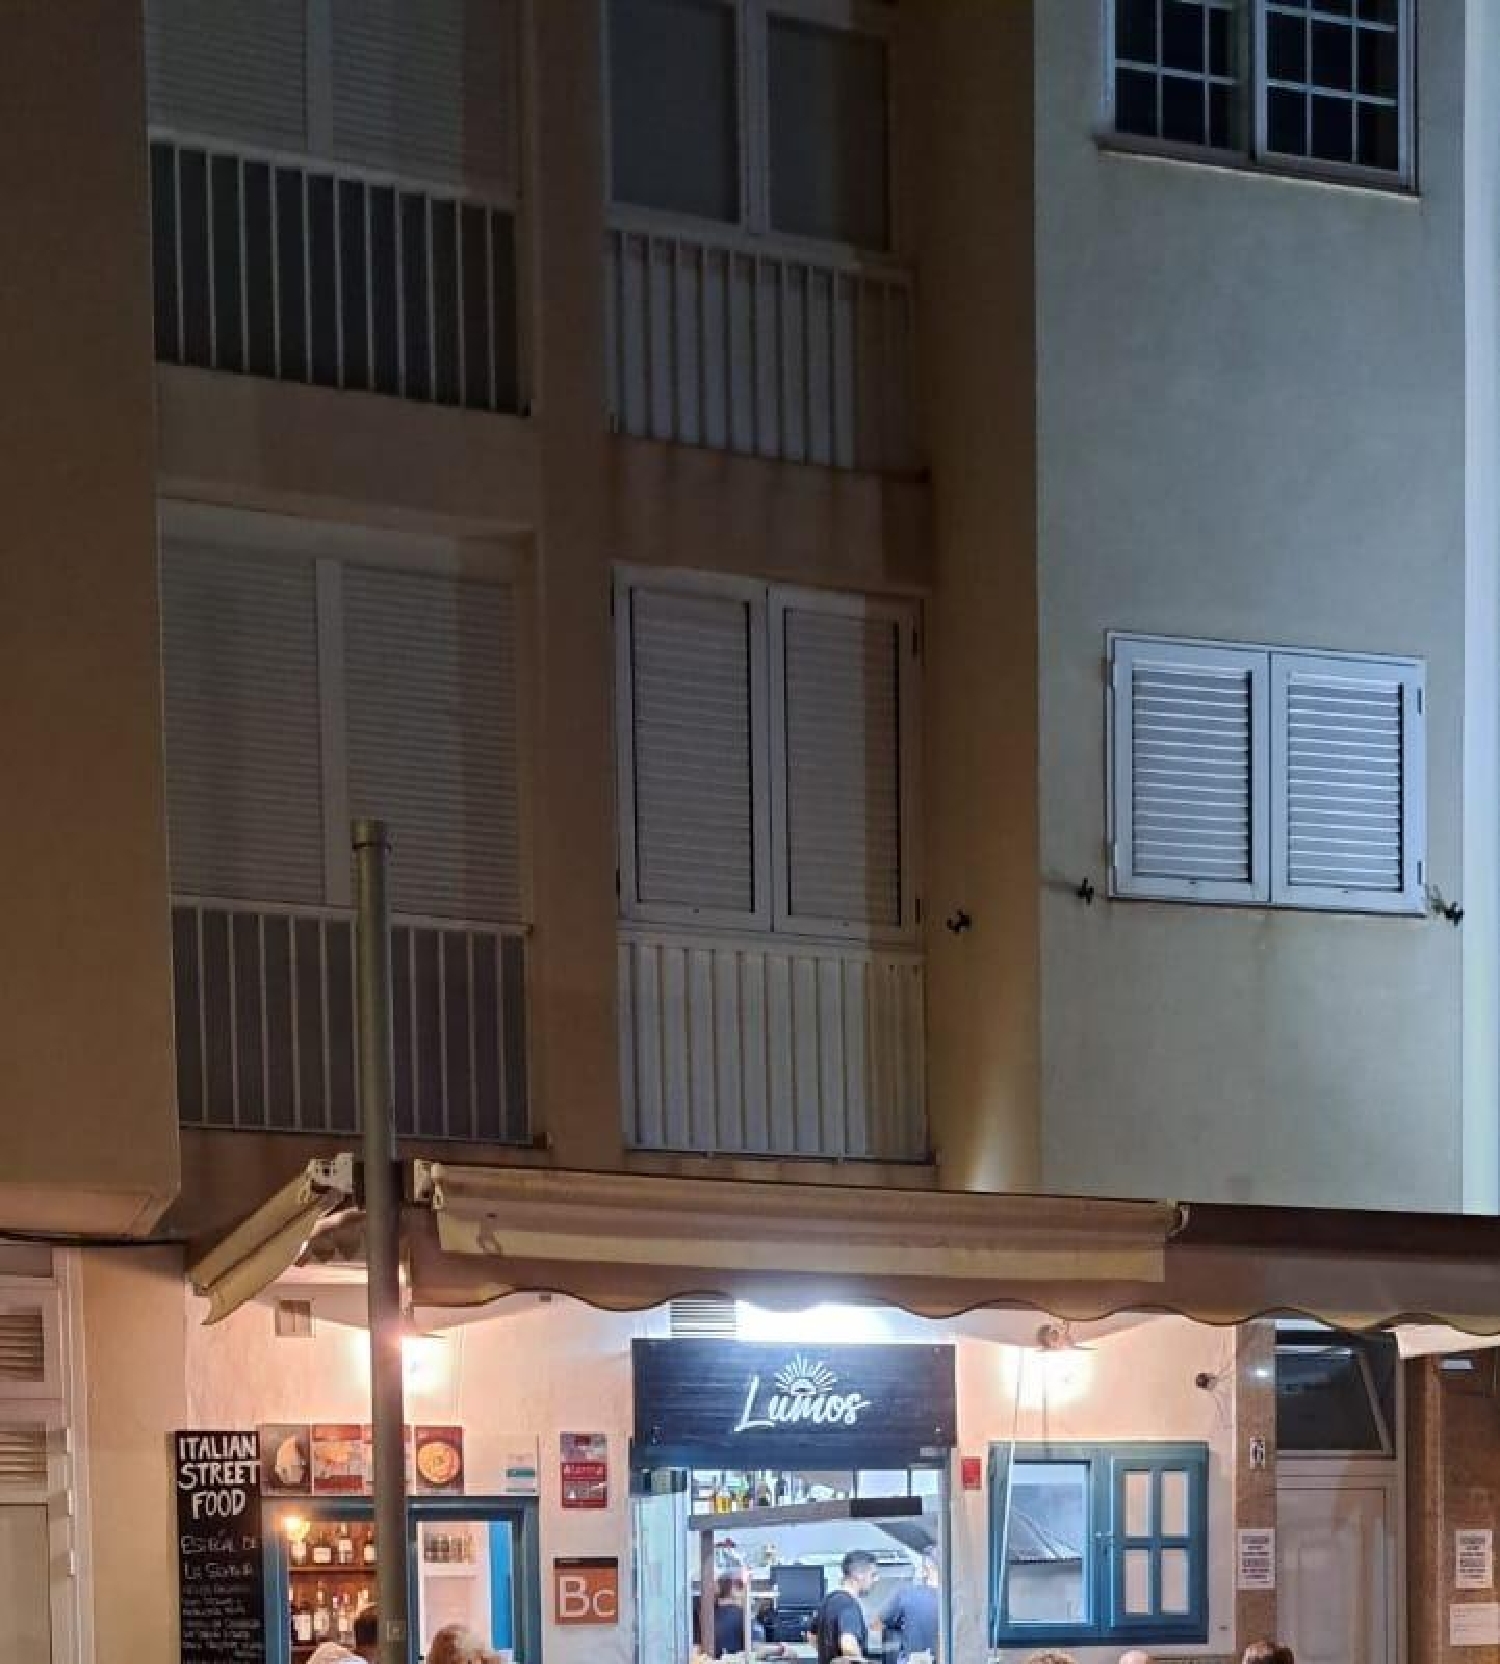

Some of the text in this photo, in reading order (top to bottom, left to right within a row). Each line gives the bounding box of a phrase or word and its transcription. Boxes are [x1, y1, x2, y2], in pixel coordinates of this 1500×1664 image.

[179, 1435, 257, 1460] ITALIAN
[178, 1460, 262, 1490] STREET
[192, 1487, 246, 1519] FOOD
